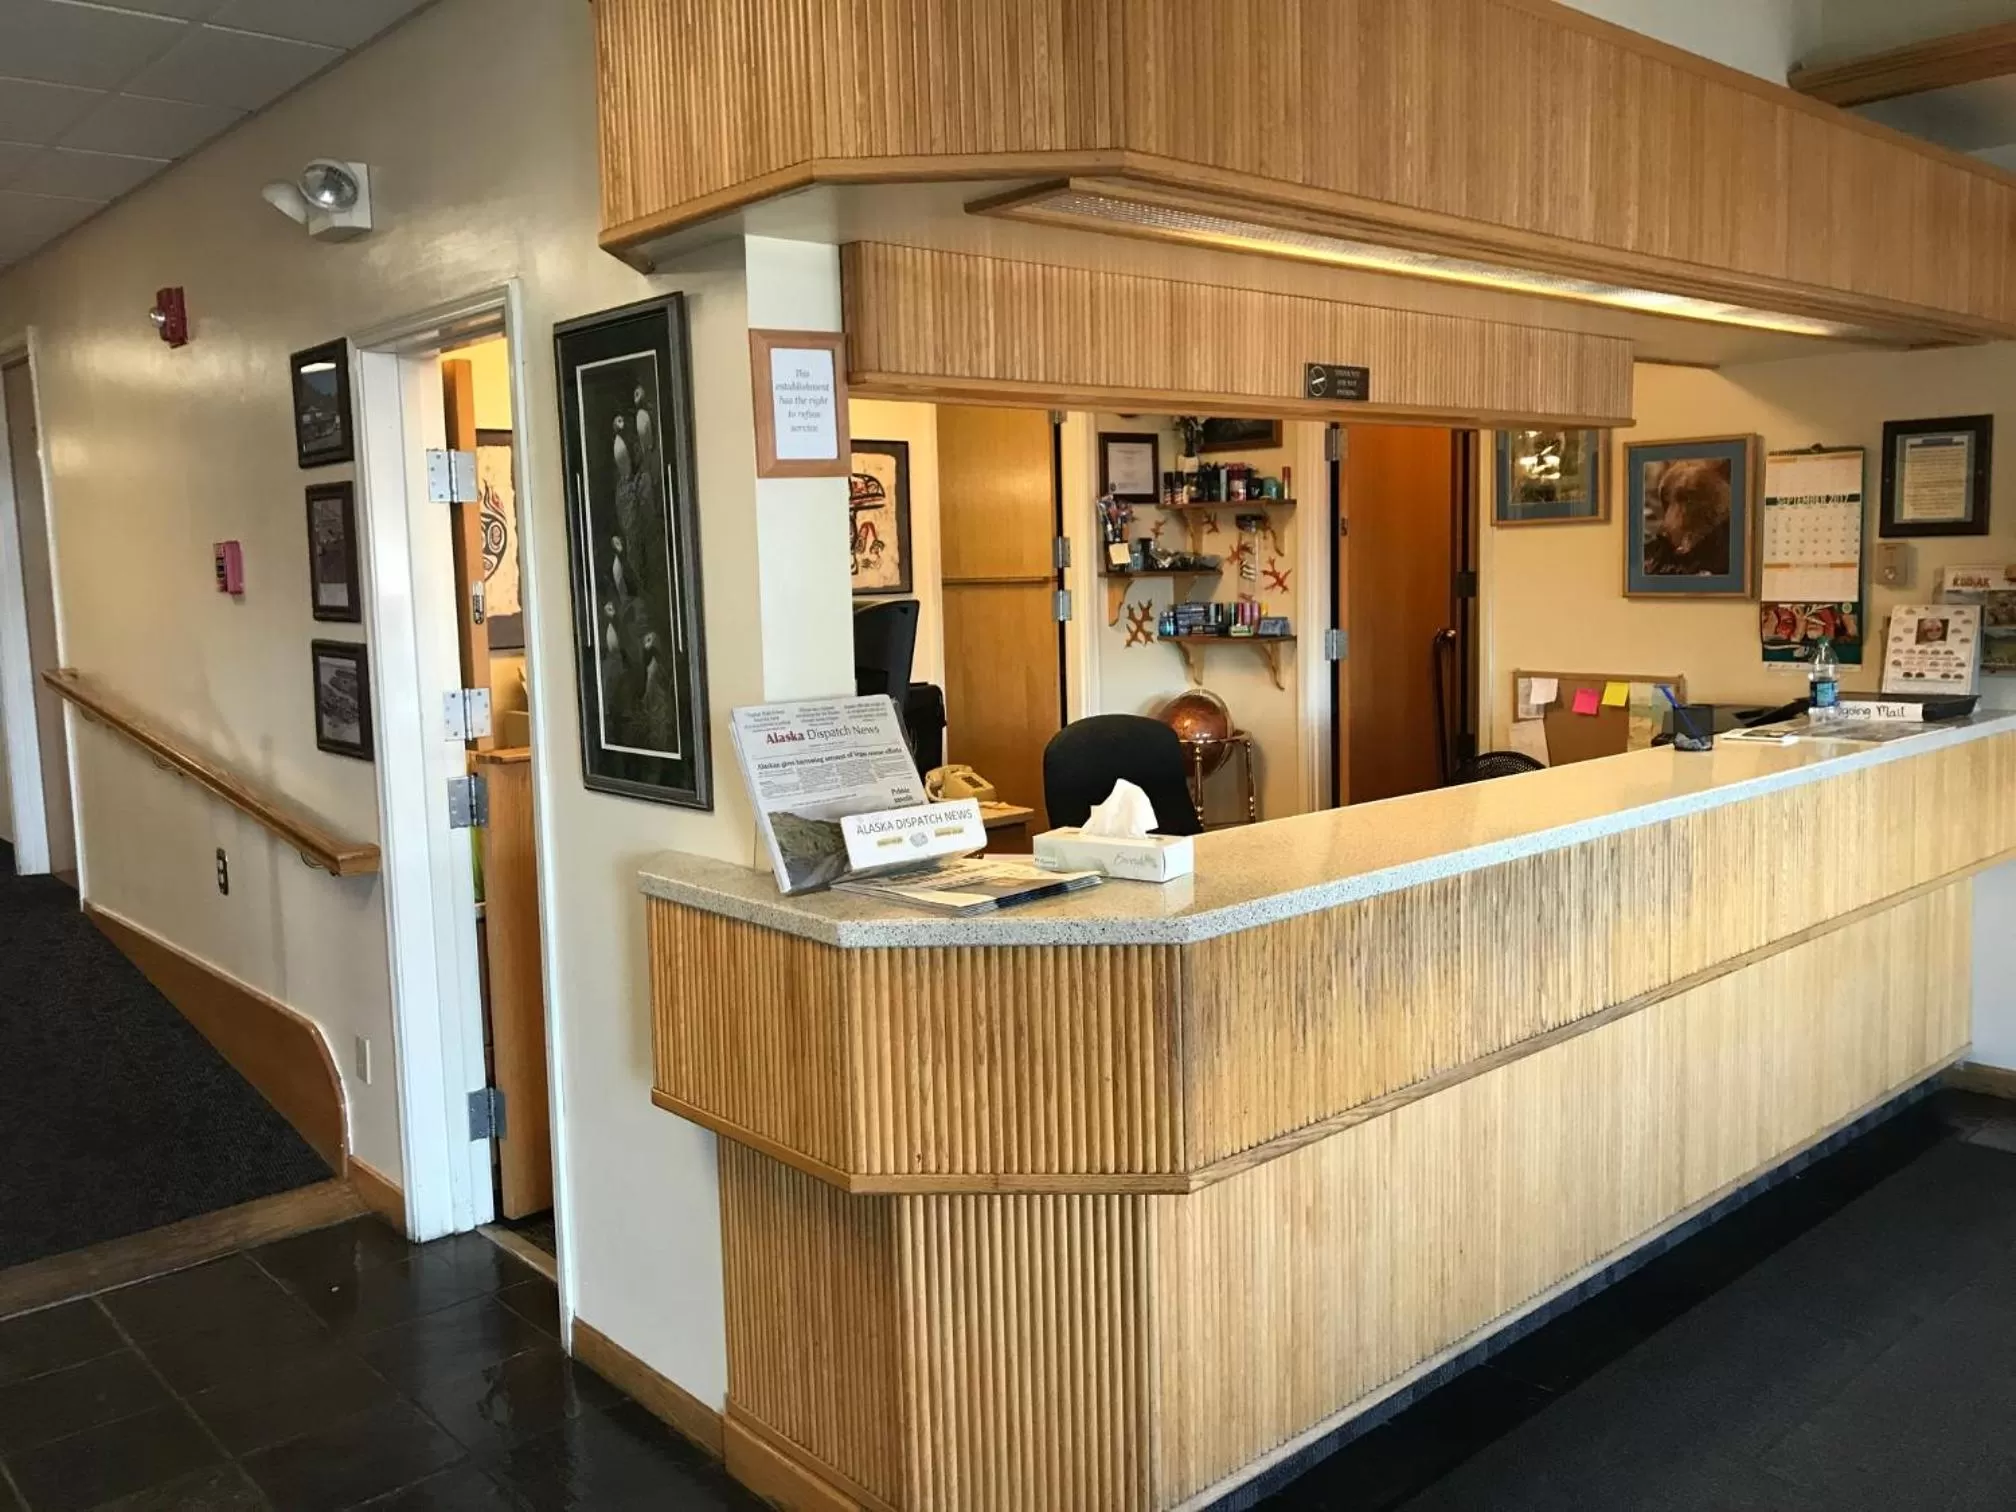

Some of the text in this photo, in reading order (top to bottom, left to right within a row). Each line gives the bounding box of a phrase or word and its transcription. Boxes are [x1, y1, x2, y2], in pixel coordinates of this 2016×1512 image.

[775, 381, 830, 391] establishment
[794, 396, 808, 405] the
[808, 396, 829, 407] right
[1875, 704, 1906, 718] Mail
[765, 723, 881, 745] Alaska Dispatch News
[856, 808, 974, 835] ALASKA DISPATCH NEWS
